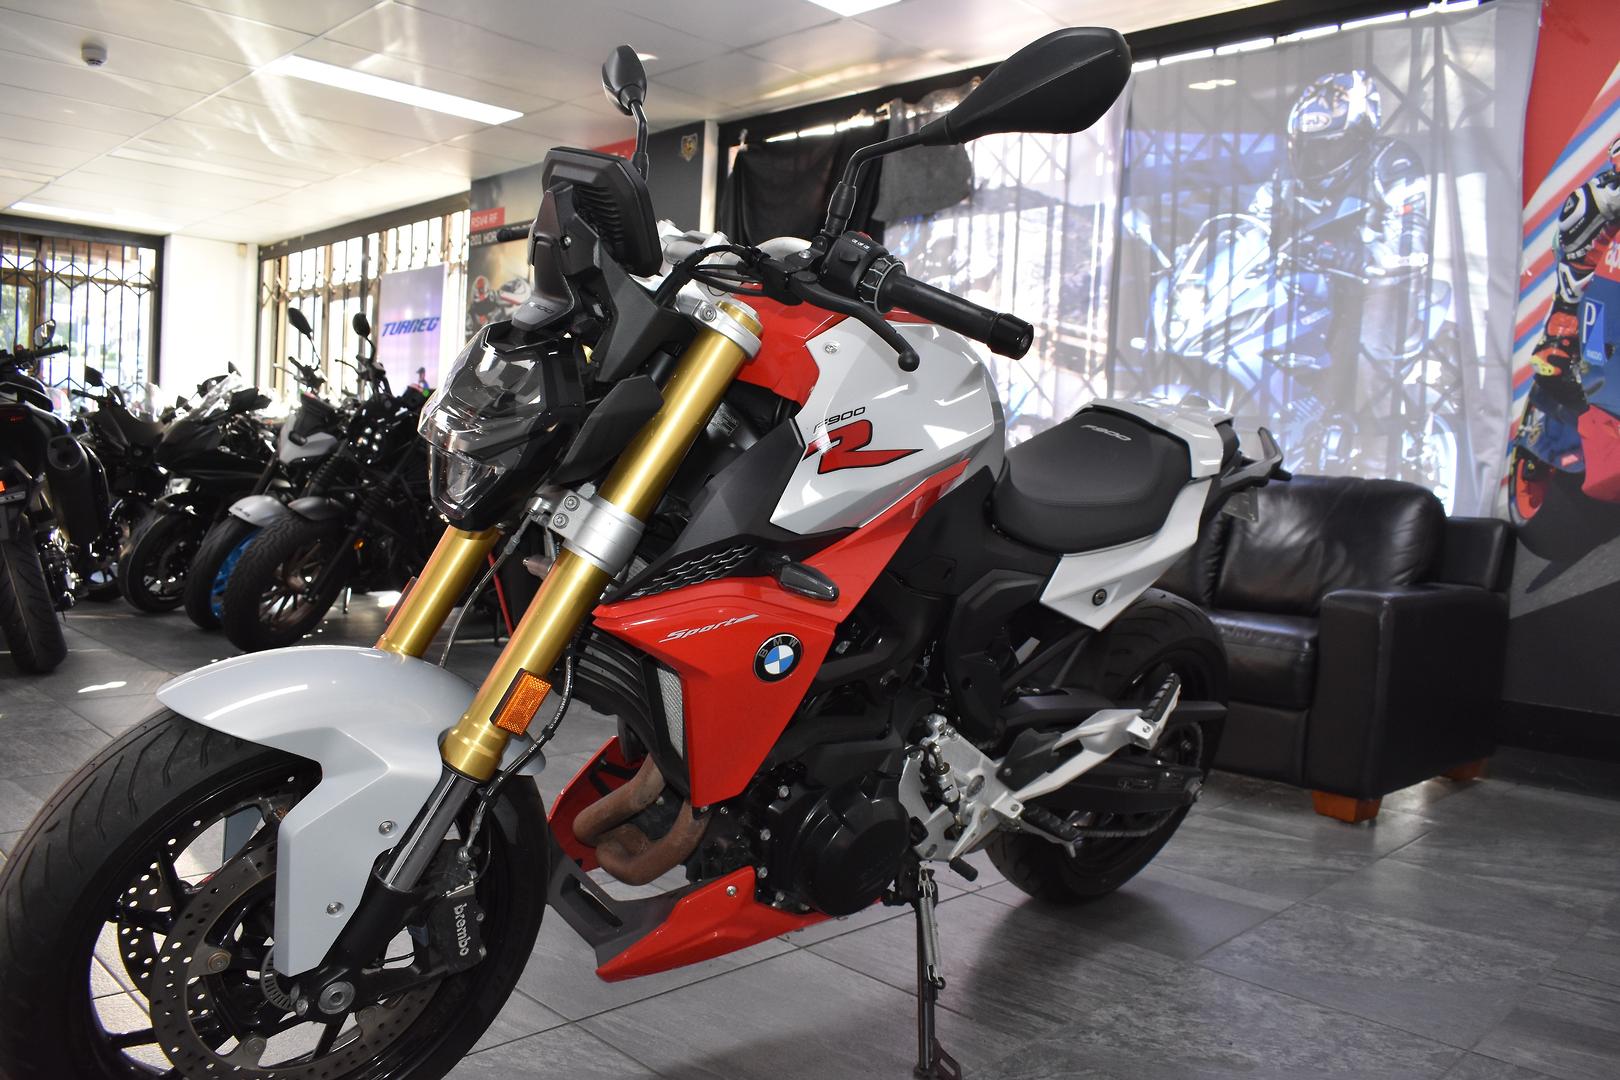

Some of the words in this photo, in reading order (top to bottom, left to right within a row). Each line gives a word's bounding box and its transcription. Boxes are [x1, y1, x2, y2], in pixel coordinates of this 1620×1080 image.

[658, 614, 759, 643] Sport
[759, 636, 800, 658] BMW
[454, 902, 472, 956] brembo
